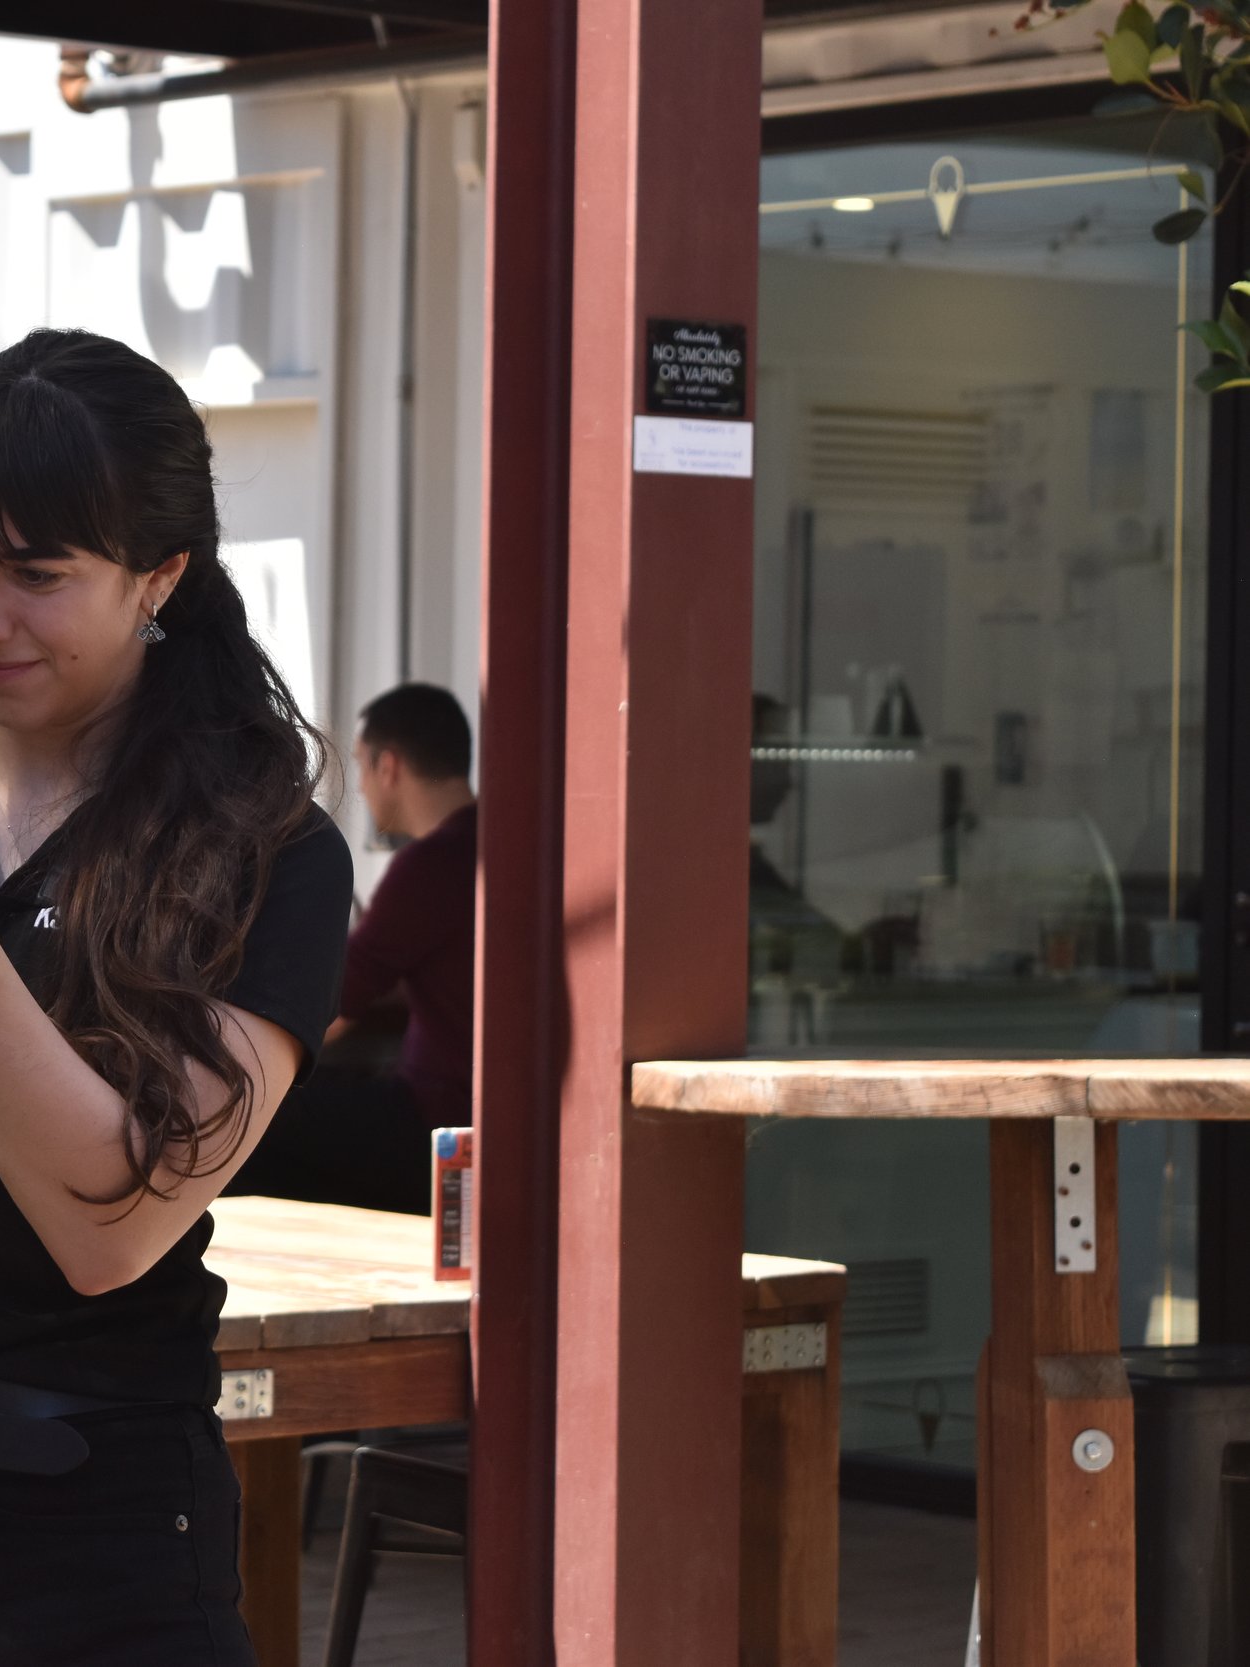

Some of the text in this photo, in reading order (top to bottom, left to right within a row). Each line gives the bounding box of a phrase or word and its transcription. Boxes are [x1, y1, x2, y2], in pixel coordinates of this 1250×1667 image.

[652, 344, 742, 367] NO SMOKING
[659, 363, 734, 384] OR VAPING
